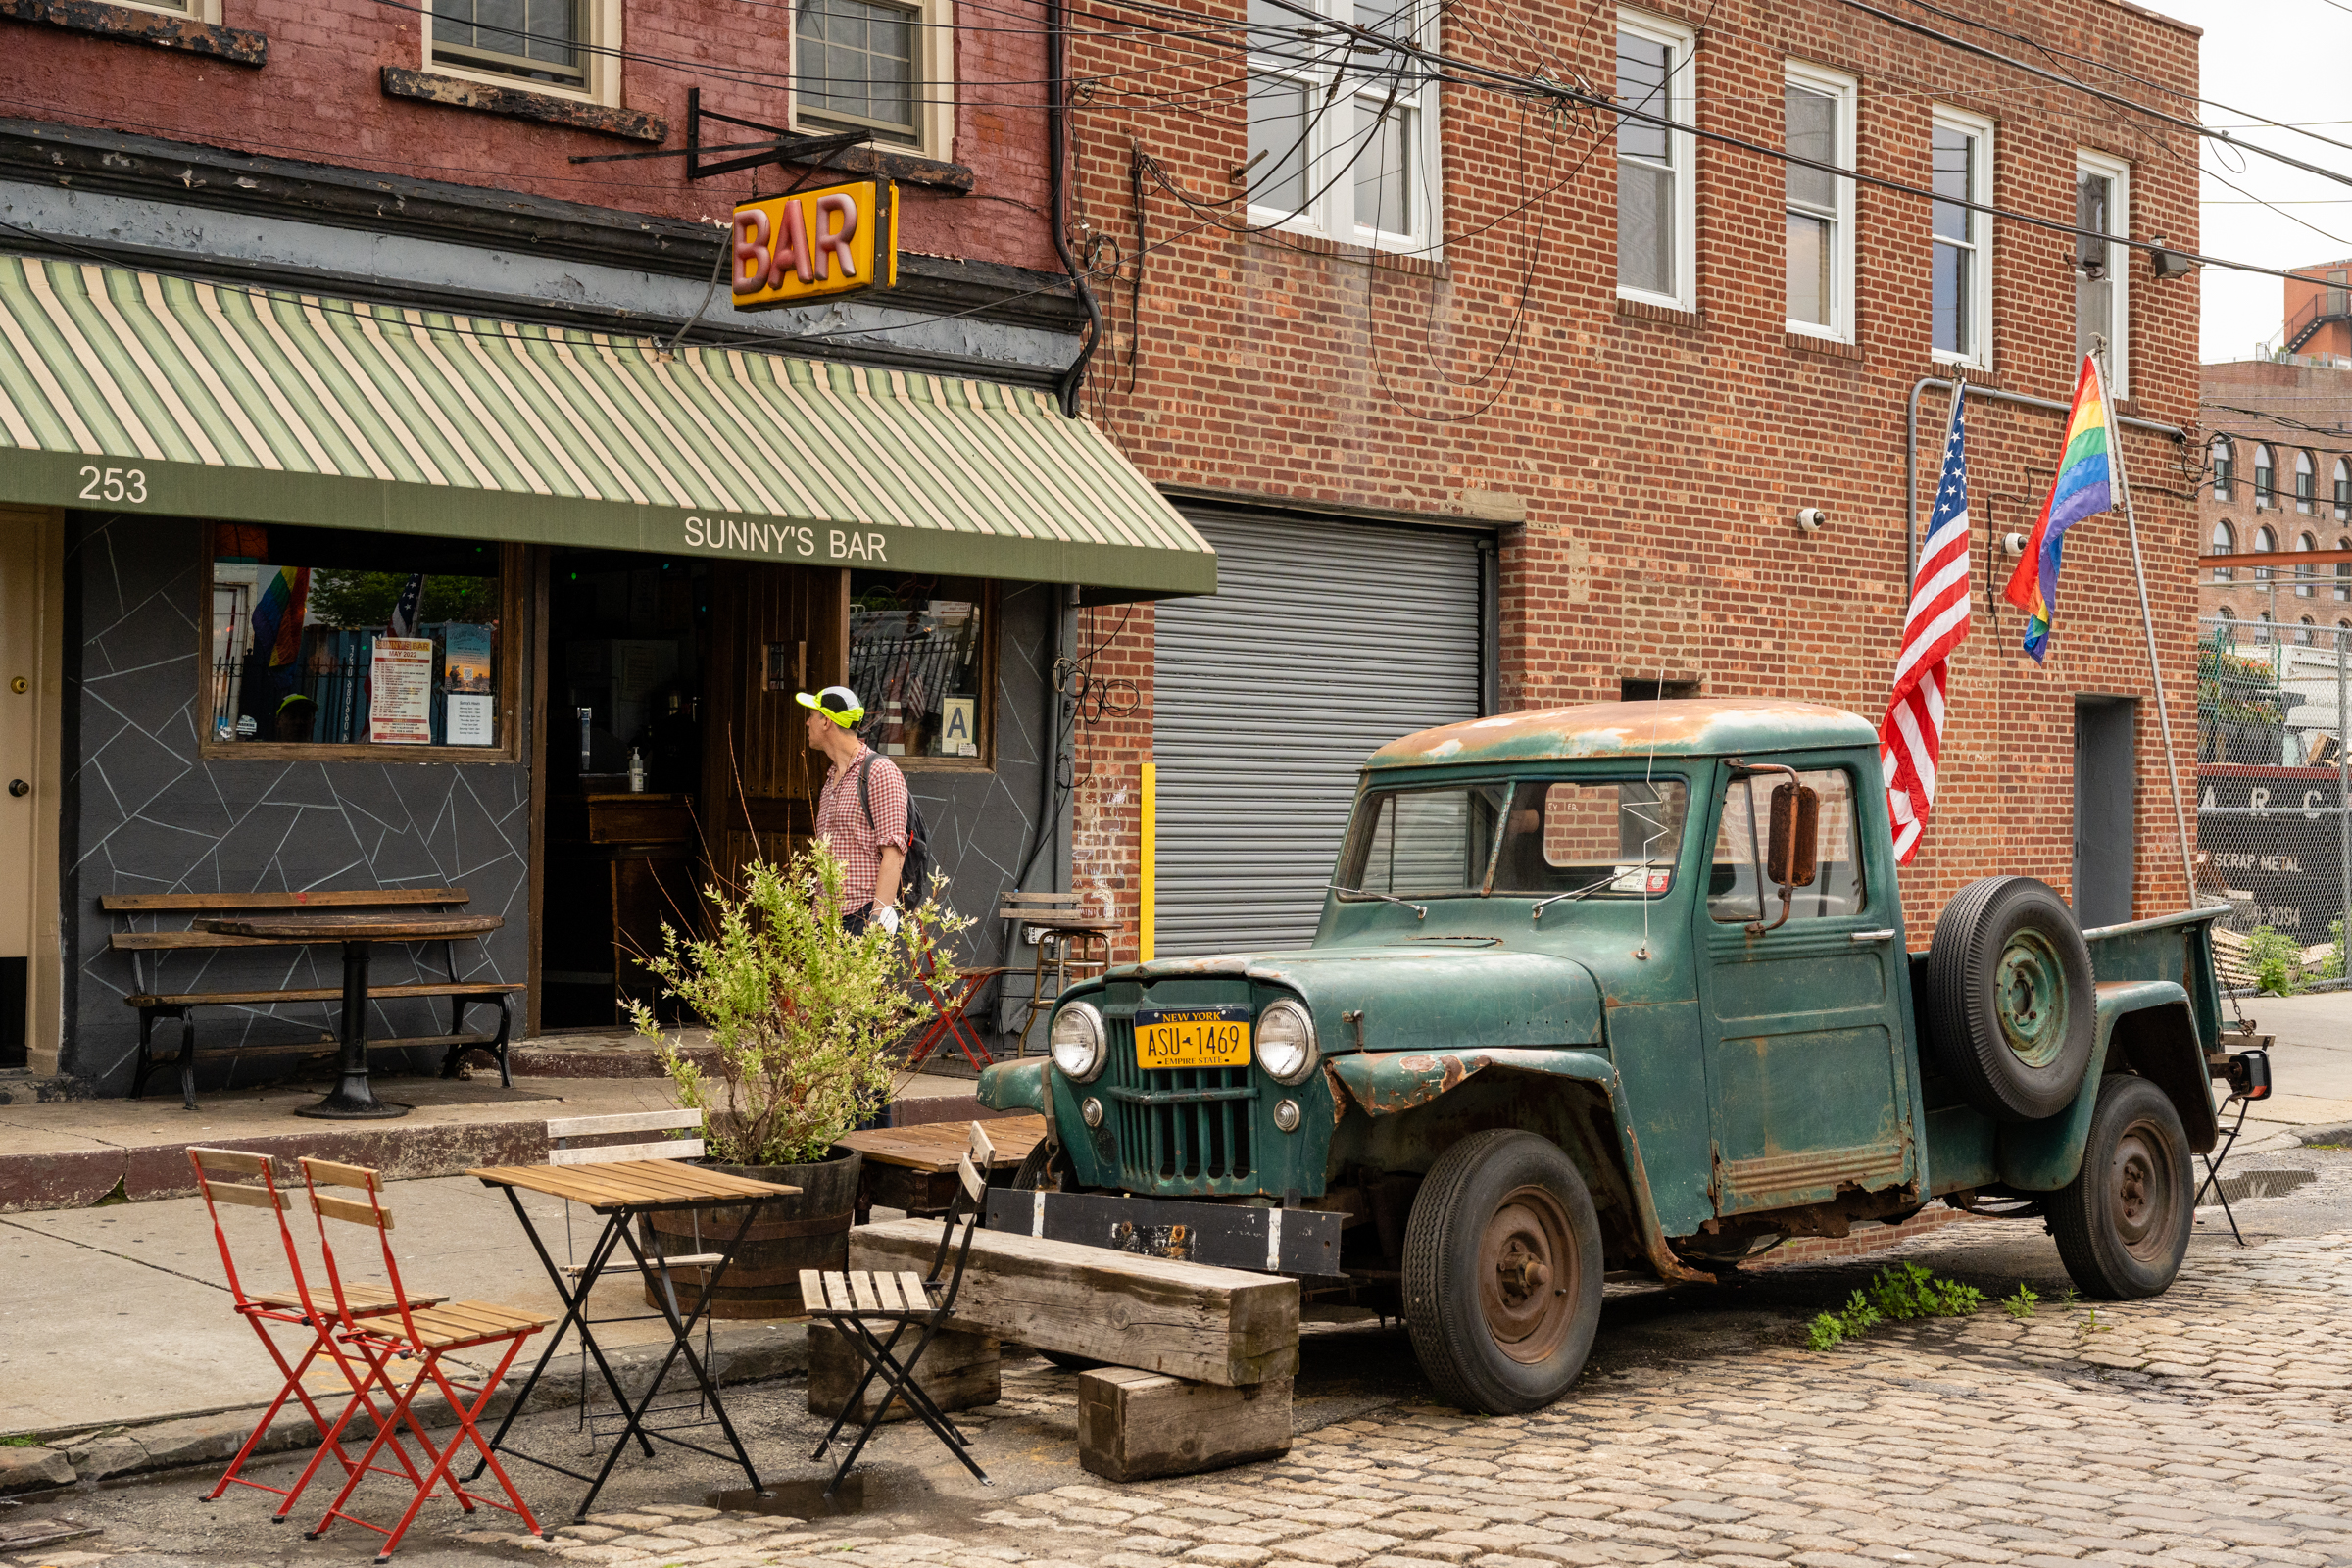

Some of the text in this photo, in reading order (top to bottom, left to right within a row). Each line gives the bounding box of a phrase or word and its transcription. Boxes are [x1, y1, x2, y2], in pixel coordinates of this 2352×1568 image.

[733, 193, 858, 295] BAR
[79, 466, 148, 504] 253
[684, 516, 888, 562] SUNNY'S BAR
[376, 640, 429, 651] SUNNY'S BAR
[947, 707, 967, 738] A
[2214, 853, 2302, 873] SCRAP METAL
[1162, 1011, 1221, 1023] NEW YORK
[1148, 1025, 1239, 1056] ASU 1469
